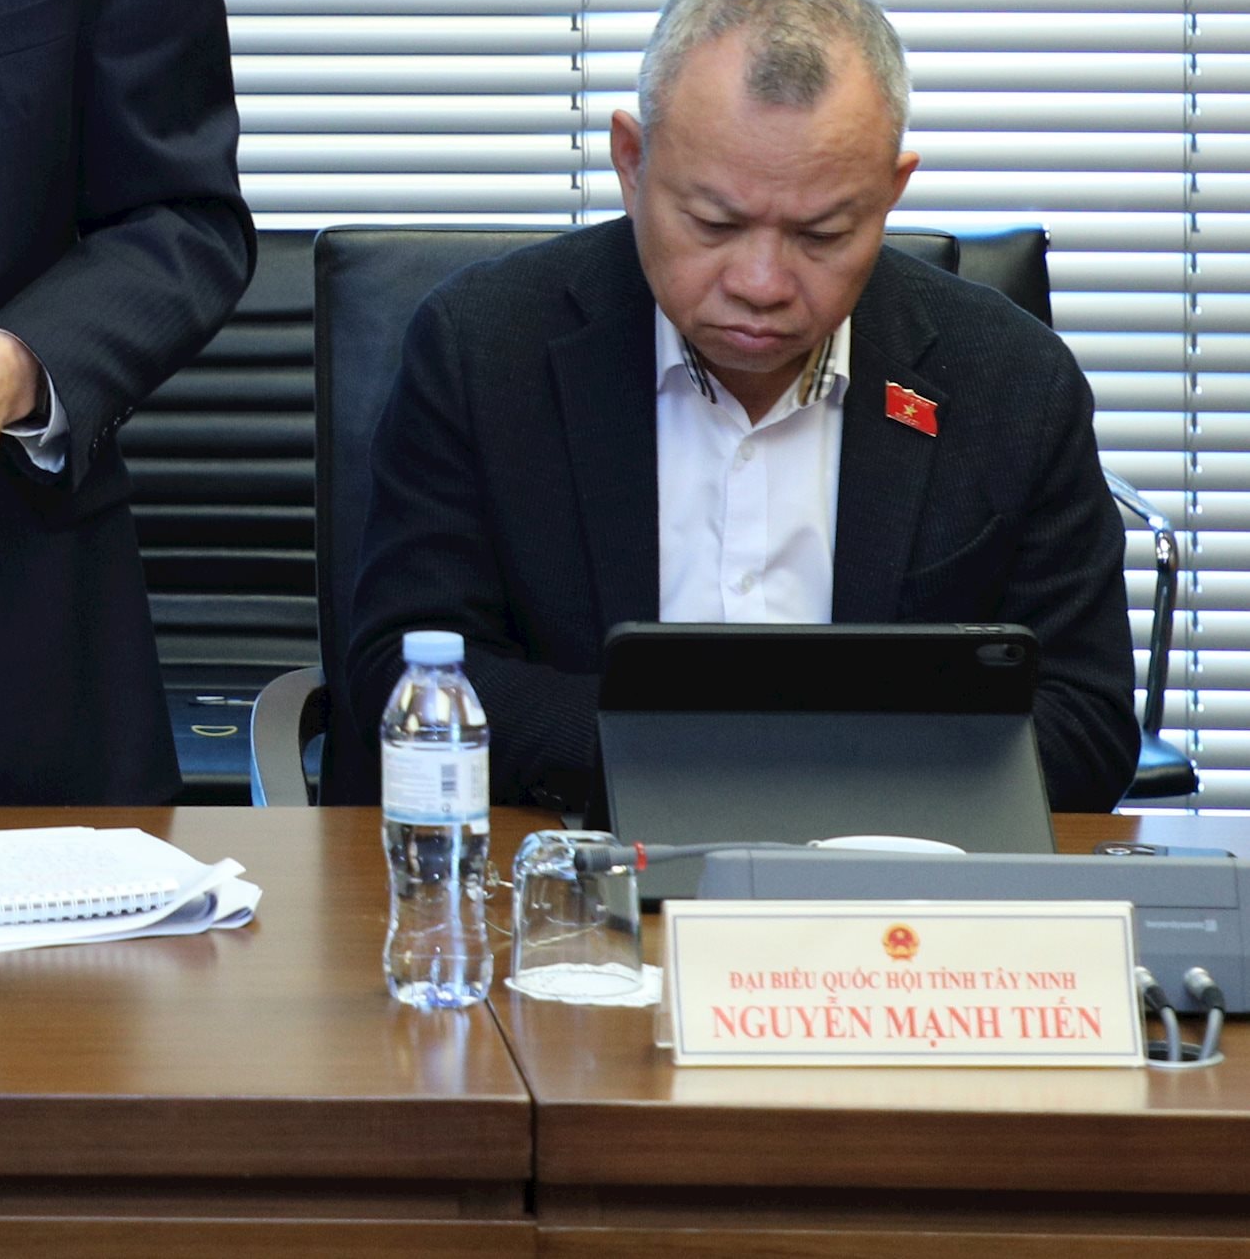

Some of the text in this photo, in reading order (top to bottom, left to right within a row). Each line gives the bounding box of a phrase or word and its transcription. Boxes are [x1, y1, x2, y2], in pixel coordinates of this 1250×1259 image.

[729, 966, 1077, 994] ĐẠI BIỂU QUỐC HỘI TỈNH TÂY NINH
[710, 995, 1102, 1048] NGUYỄN MẠNH TIẾN
